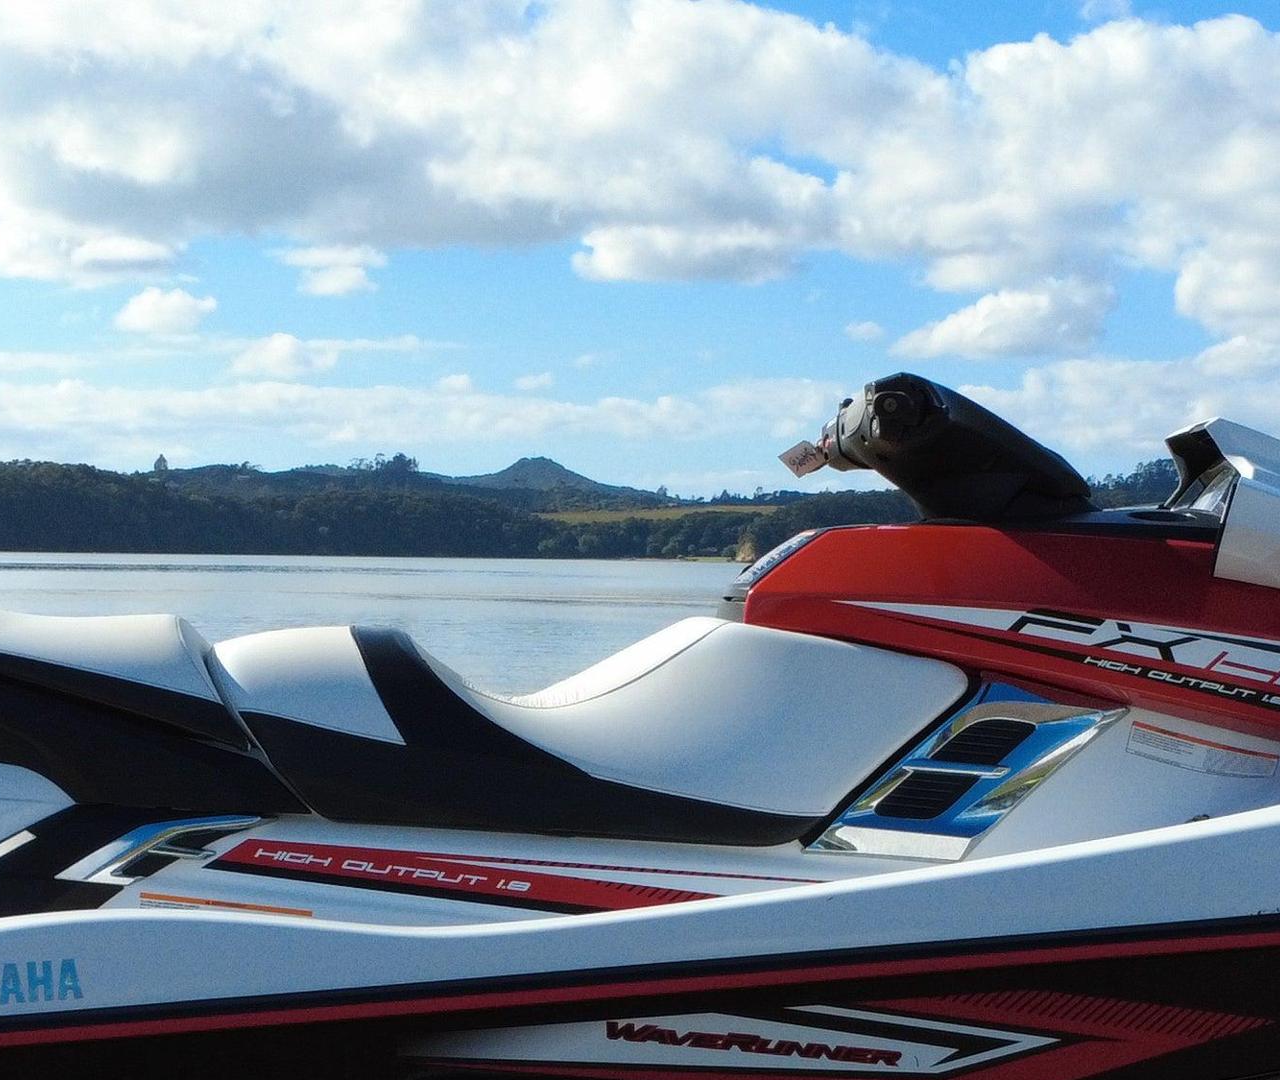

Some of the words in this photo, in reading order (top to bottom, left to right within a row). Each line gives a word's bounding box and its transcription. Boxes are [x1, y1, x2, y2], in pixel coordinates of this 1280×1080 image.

[1084, 656, 1143, 675] HIGH
[1147, 670, 1257, 699] OUTPUT
[254, 848, 333, 868] HIGH
[341, 859, 488, 886] OUTPUT
[496, 879, 532, 893] 1.8
